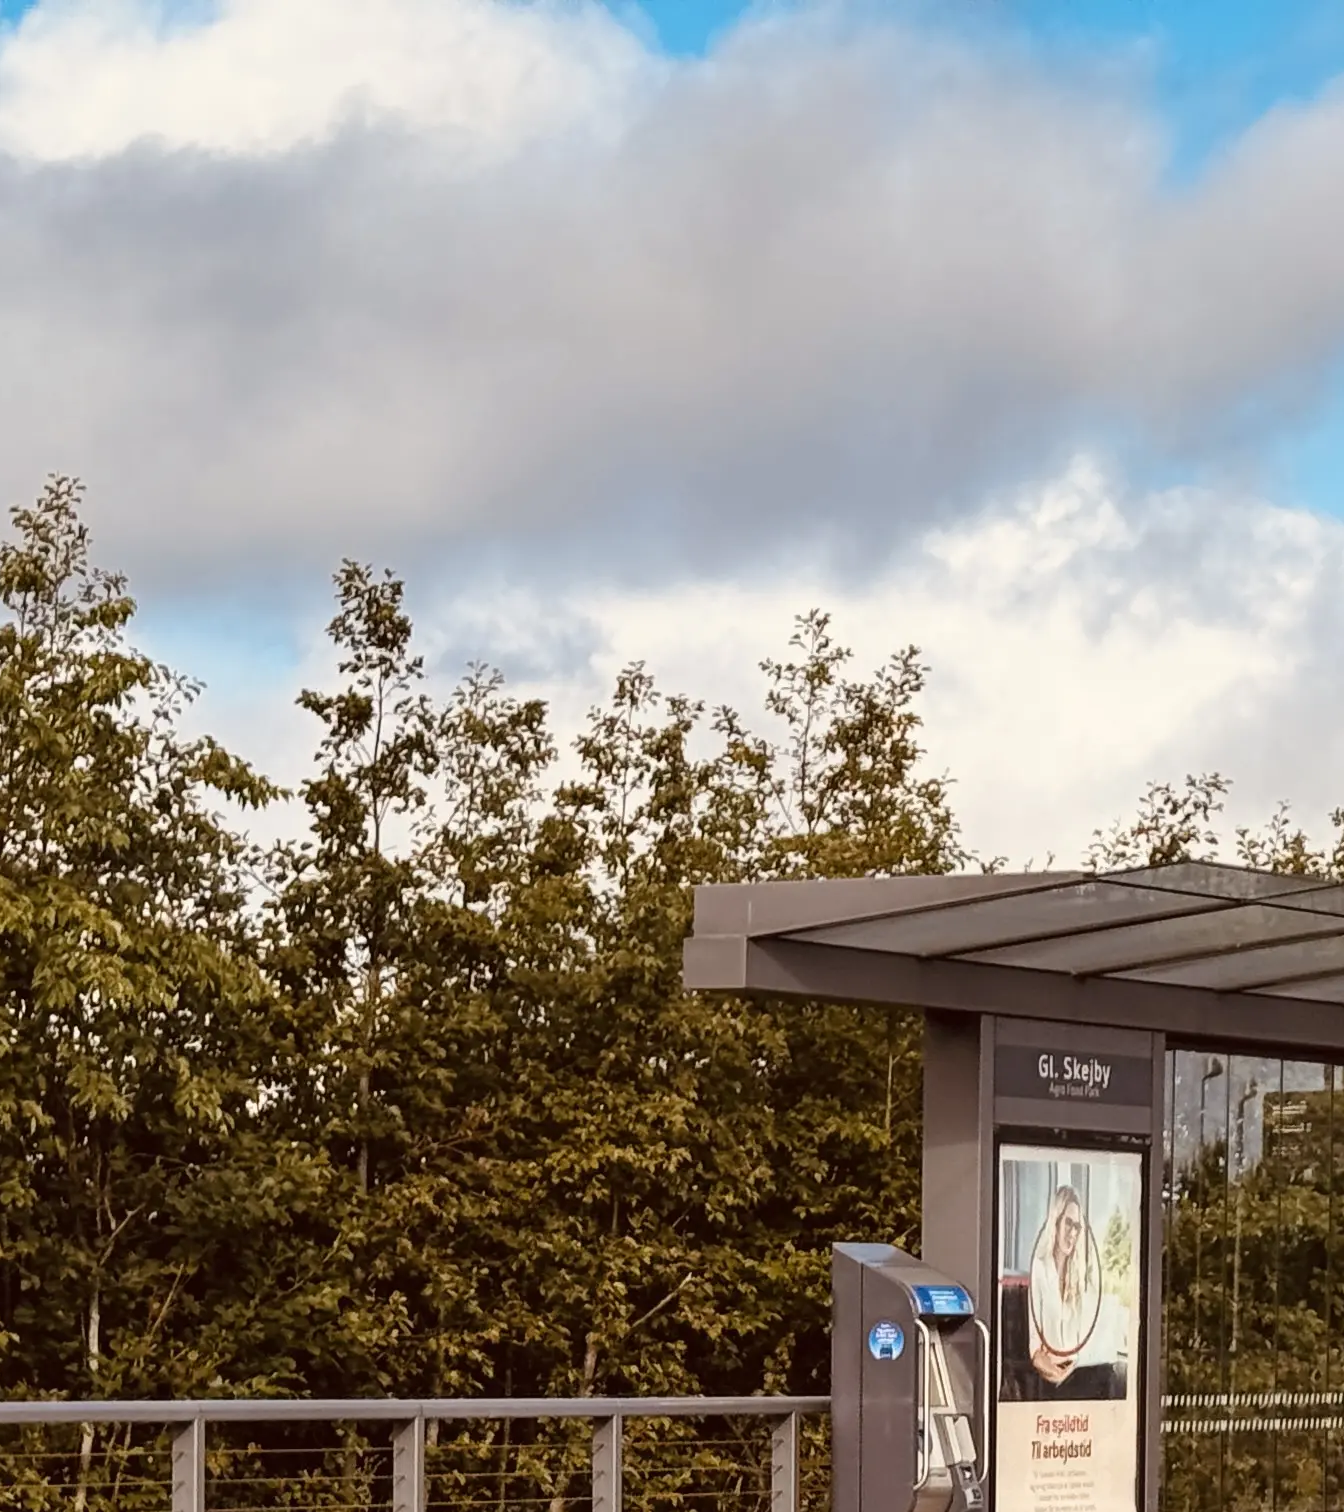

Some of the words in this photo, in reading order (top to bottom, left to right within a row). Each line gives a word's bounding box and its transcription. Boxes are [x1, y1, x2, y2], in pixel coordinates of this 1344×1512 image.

[1038, 1053, 1059, 1079] Gl.
[1063, 1056, 1111, 1089] Skejby
[1036, 1414, 1051, 1434] Fra
[1051, 1413, 1089, 1438] spildtid
[1031, 1440, 1042, 1460] Til
[1043, 1439, 1092, 1465] arbejdstid
